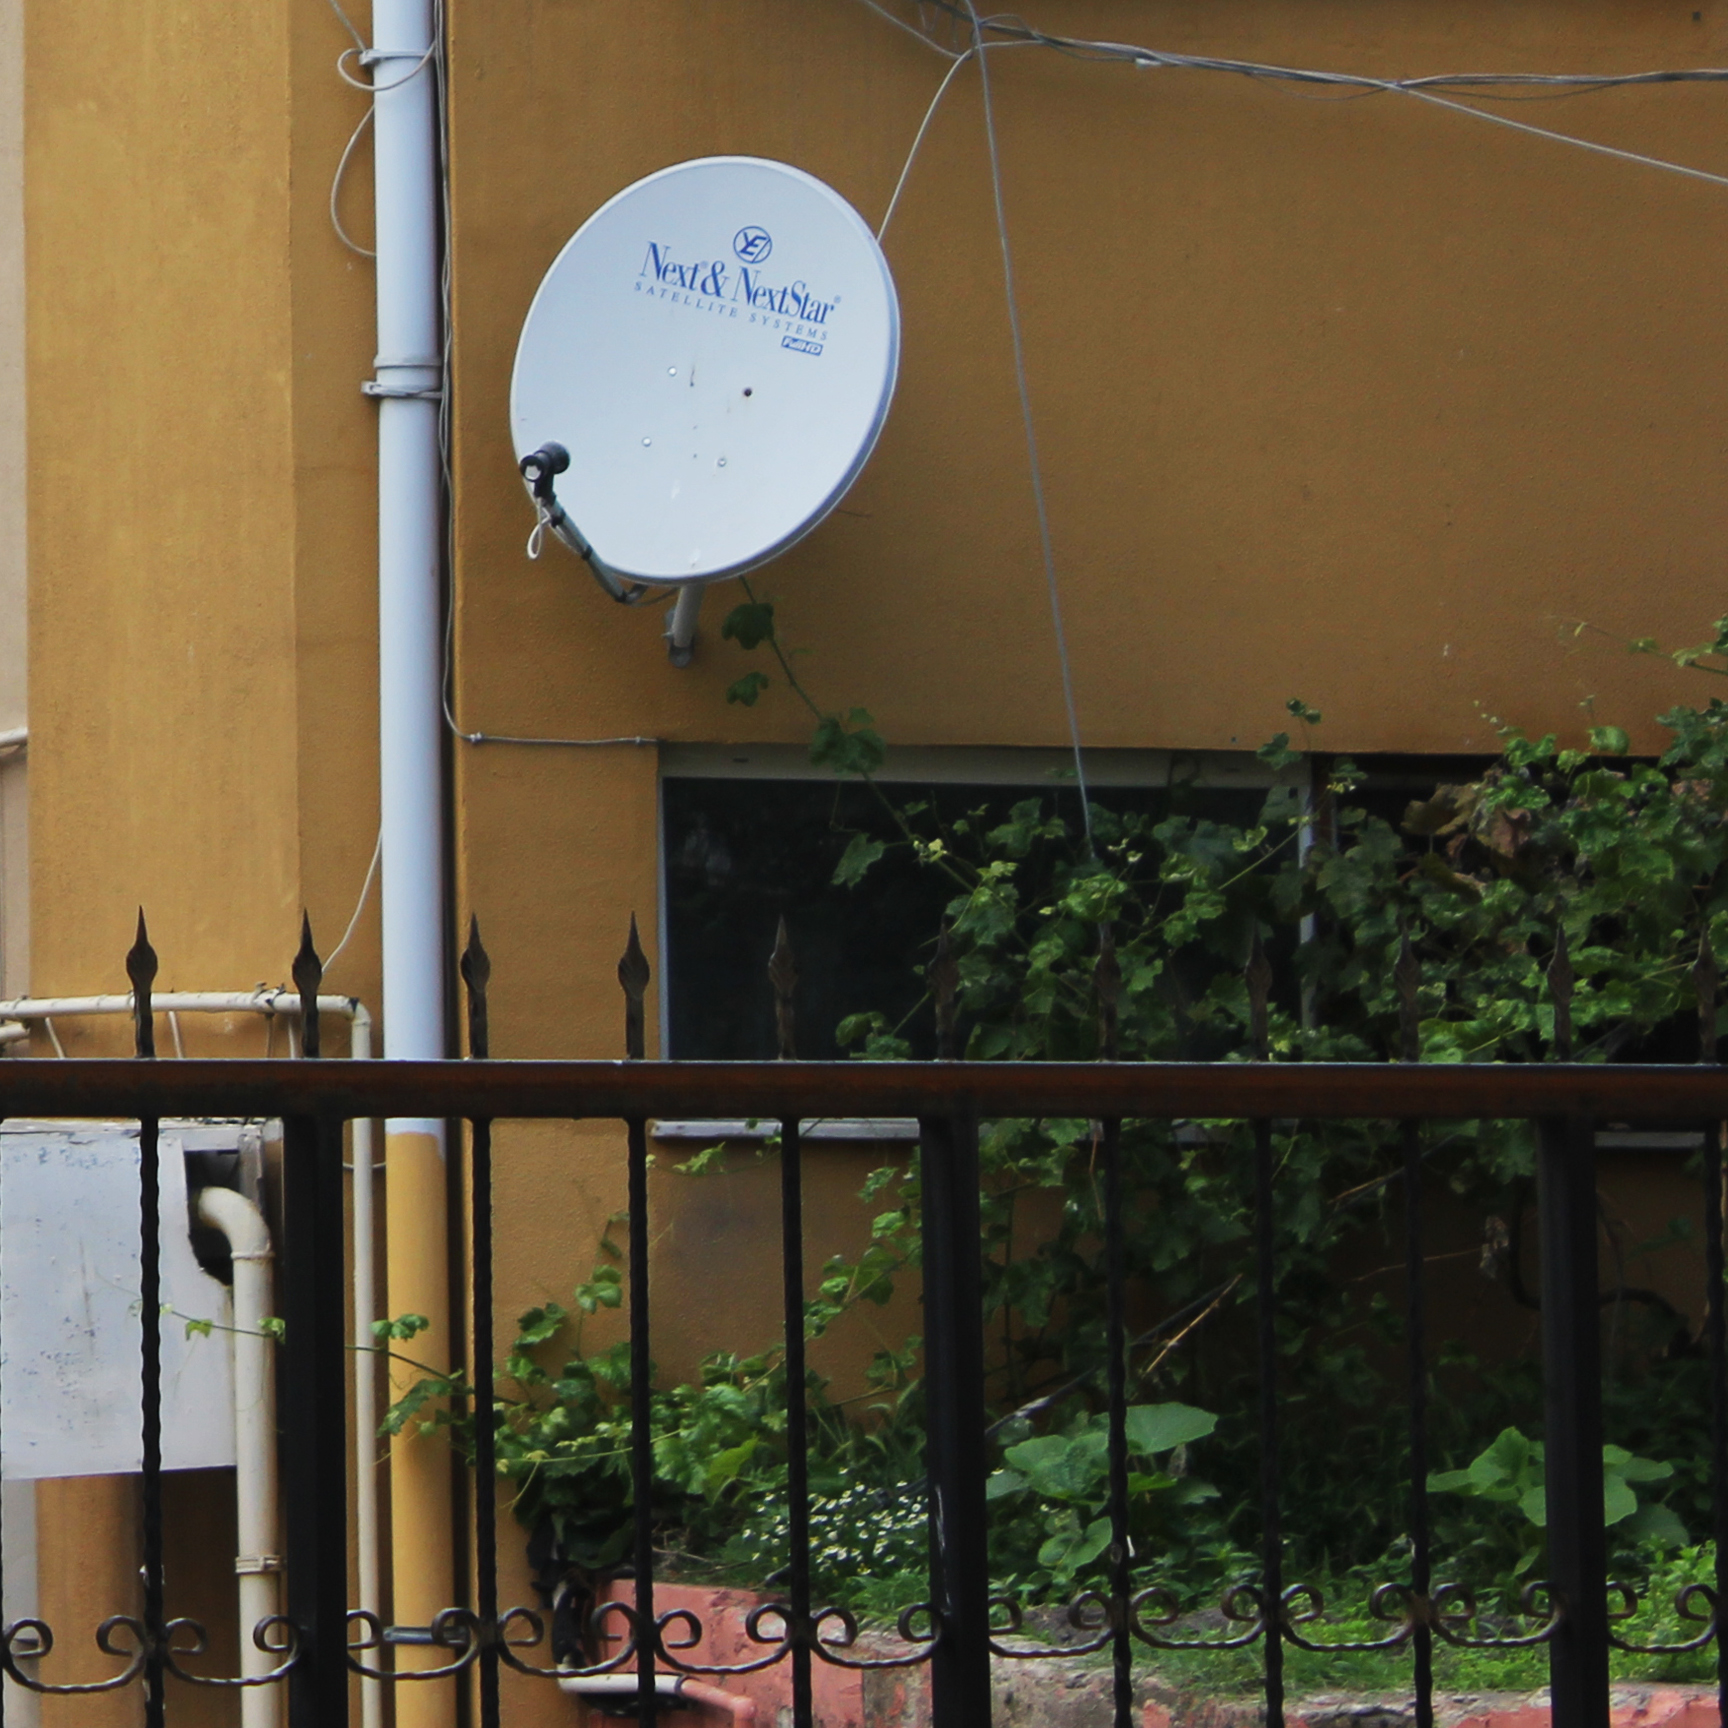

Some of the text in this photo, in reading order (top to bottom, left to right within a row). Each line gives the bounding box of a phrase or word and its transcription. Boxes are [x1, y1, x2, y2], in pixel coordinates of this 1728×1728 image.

[634, 280, 829, 342] SATELLITE SYSTEMS
[639, 241, 700, 292] Next
[731, 265, 835, 325] NextStar
